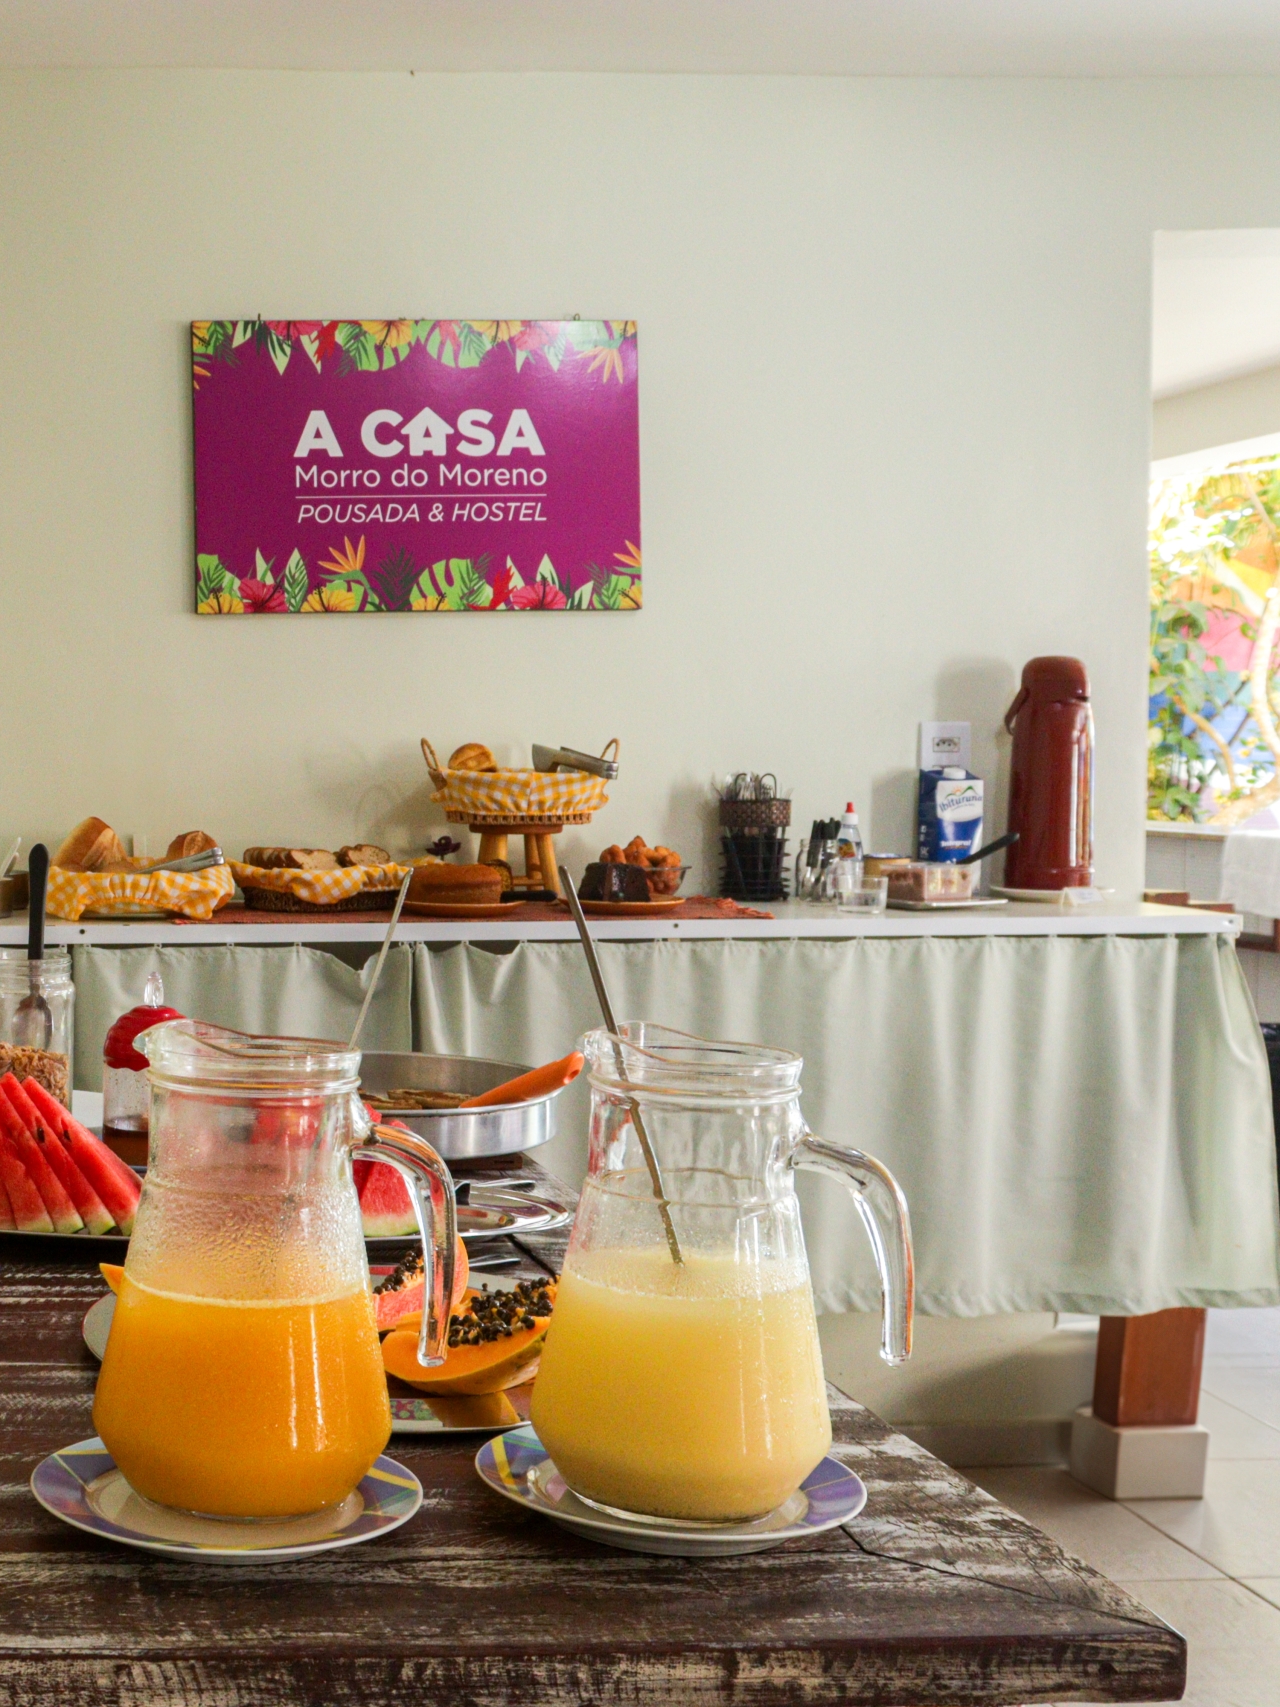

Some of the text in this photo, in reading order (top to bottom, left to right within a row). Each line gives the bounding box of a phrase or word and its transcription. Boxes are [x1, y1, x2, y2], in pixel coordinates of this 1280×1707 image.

[293, 407, 547, 458] A CASA
[295, 463, 548, 488] Morro do Moreno
[297, 502, 548, 524] POUSADA & HOSTEL
